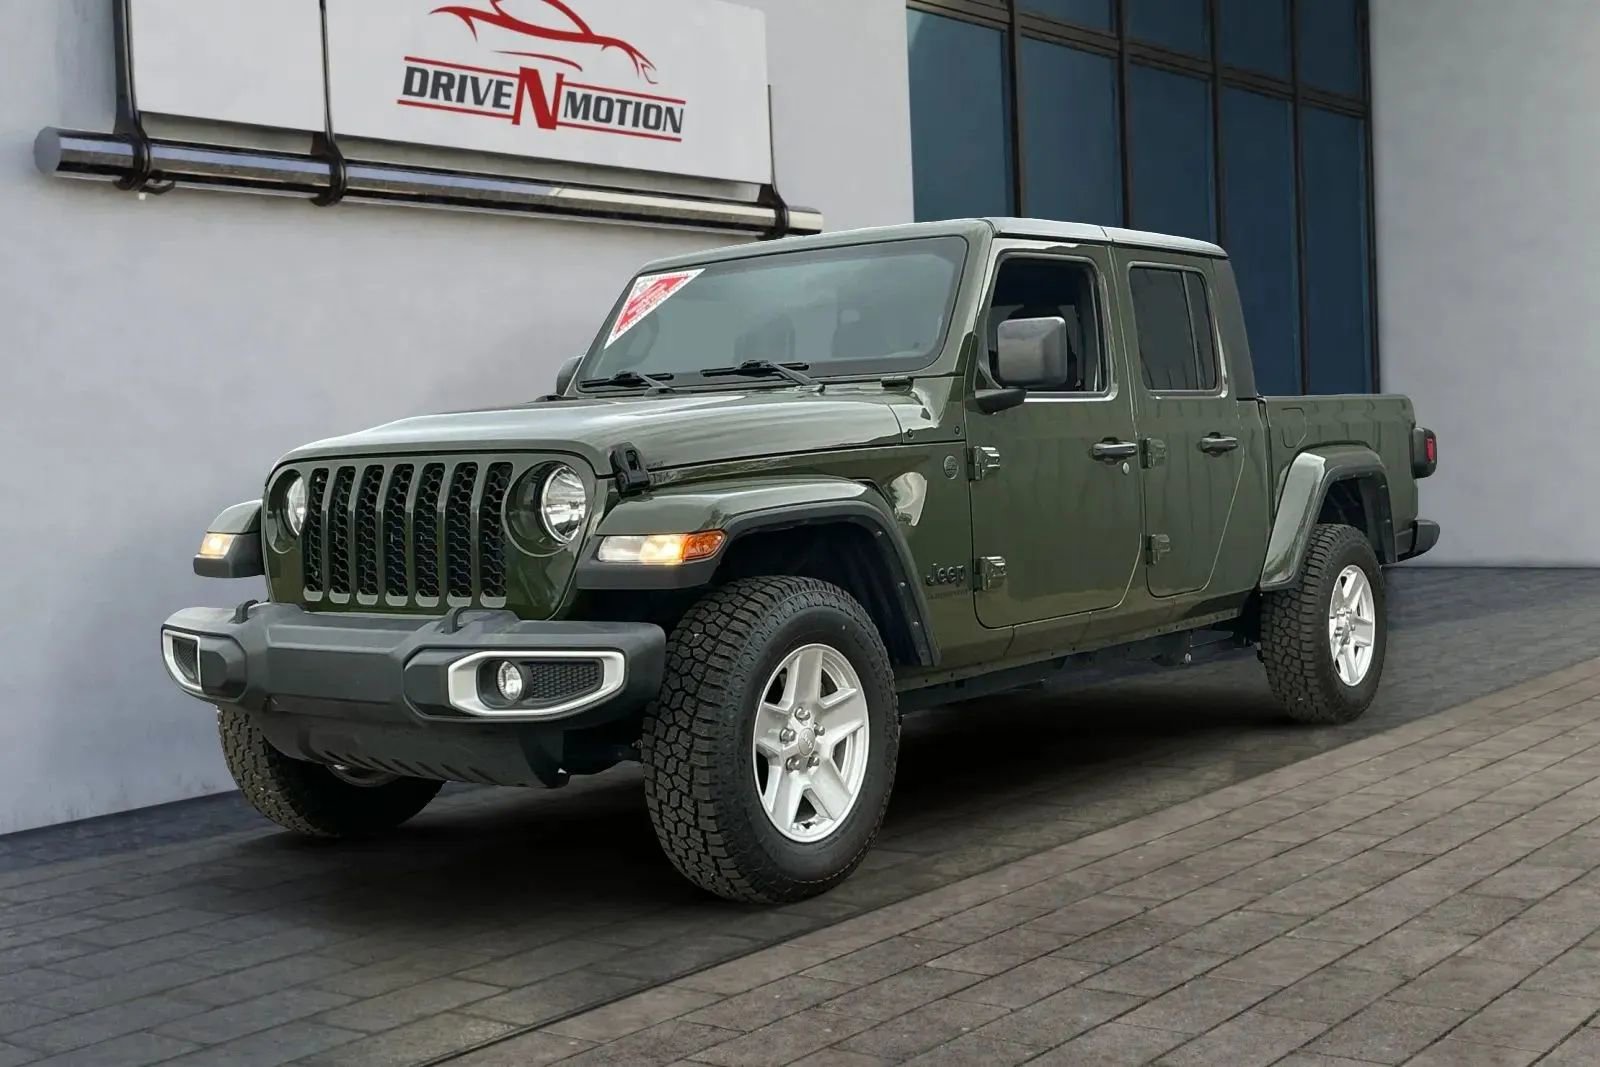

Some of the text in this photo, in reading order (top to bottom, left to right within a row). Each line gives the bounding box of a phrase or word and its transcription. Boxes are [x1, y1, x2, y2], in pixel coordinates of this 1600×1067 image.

[402, 65, 684, 134] DRIVE N MOTION
[926, 562, 966, 587] Jeep
